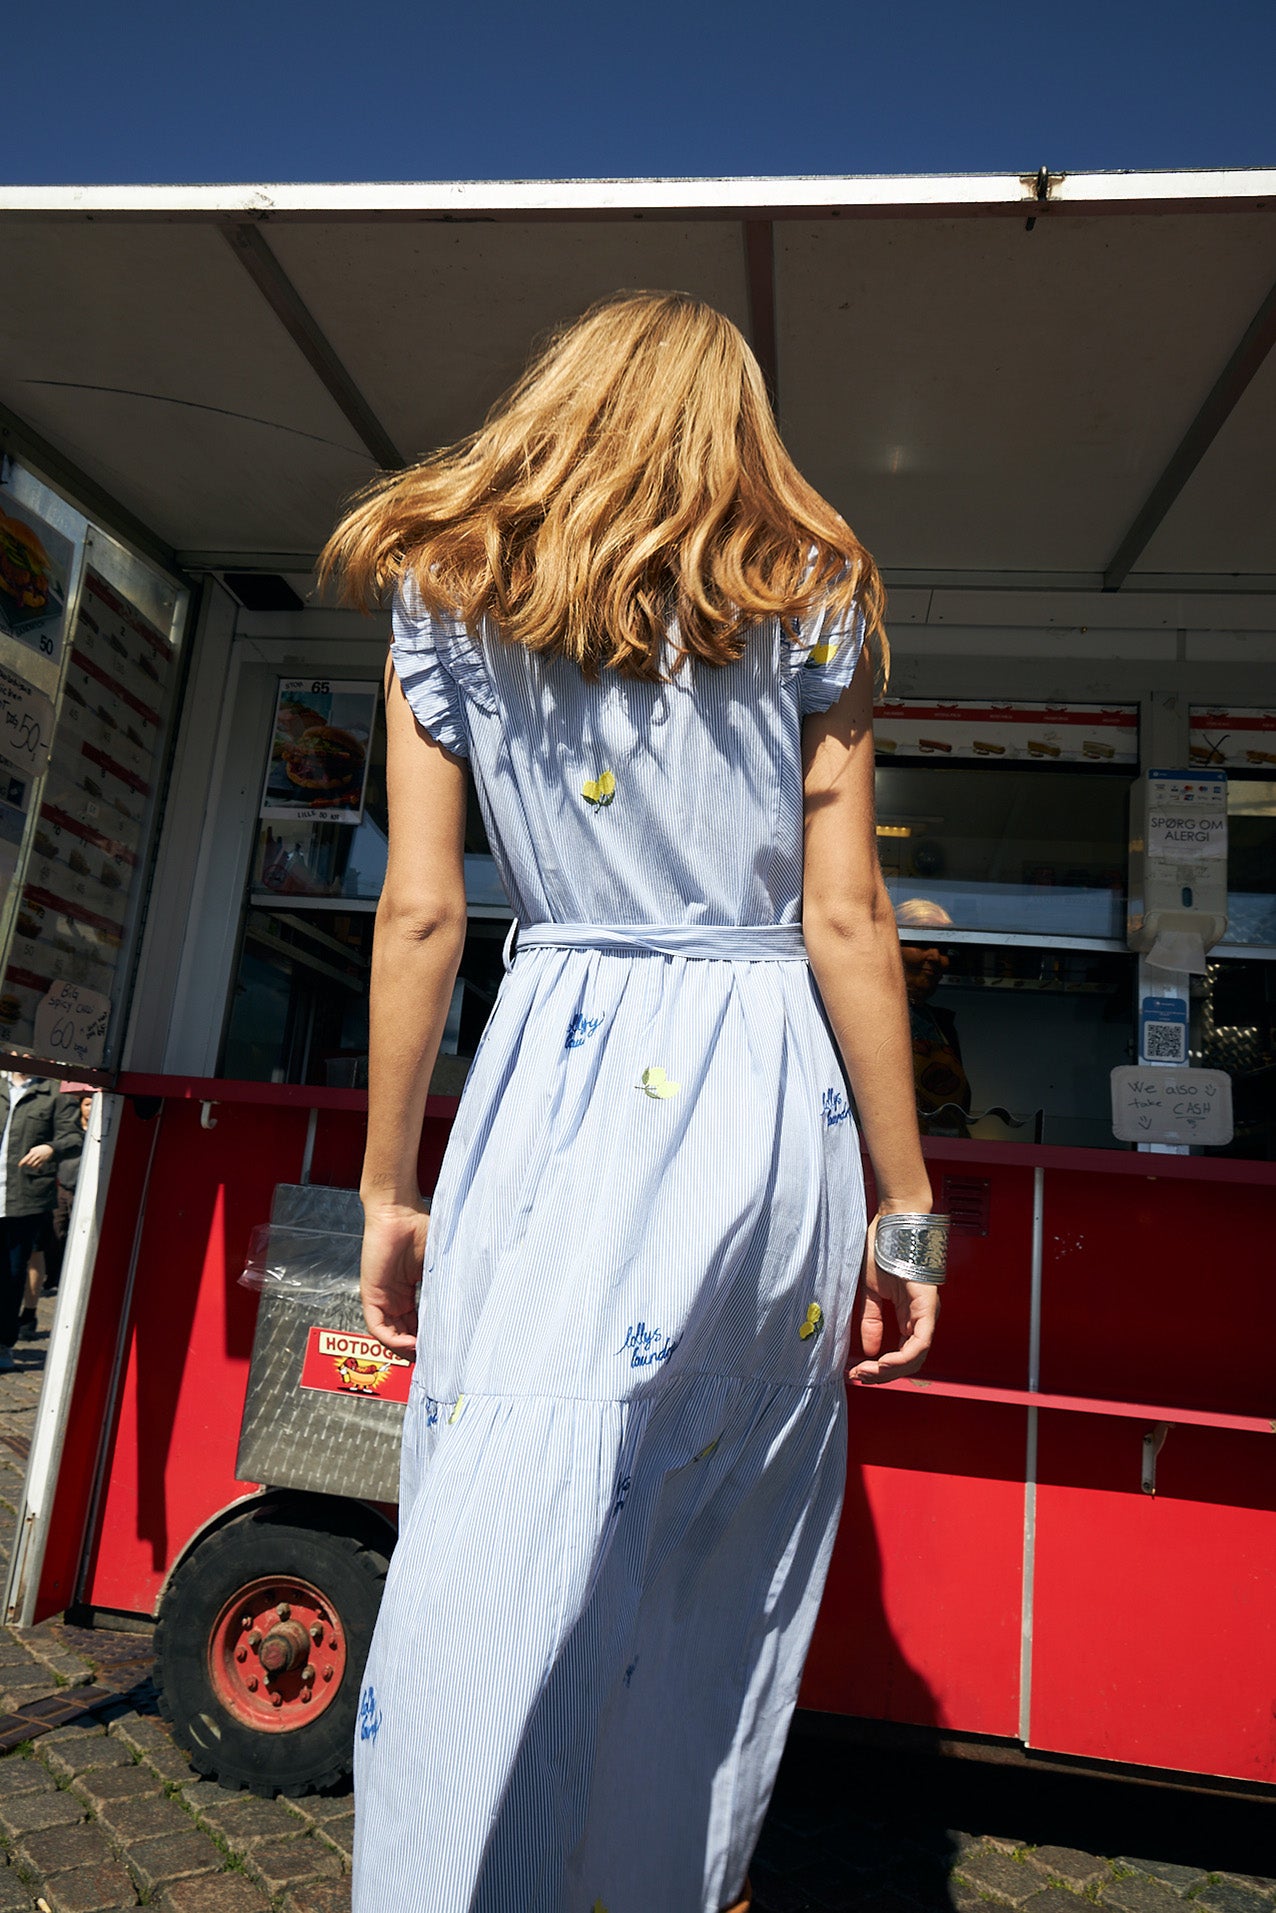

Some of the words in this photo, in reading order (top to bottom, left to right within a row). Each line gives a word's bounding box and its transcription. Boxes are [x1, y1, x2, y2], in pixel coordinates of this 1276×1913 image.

[40, 633, 53, 655] 50
[311, 681, 330, 694] 65
[1151, 817, 1195, 830] SPØRG
[1199, 819, 1224, 831] OM
[1164, 831, 1210, 842] ALERGI
[50, 1017, 75, 1049] 60
[1128, 1081, 1157, 1094] We
[1165, 1084, 1198, 1095] also
[1128, 1099, 1163, 1109] take
[1173, 1102, 1211, 1116] CASH
